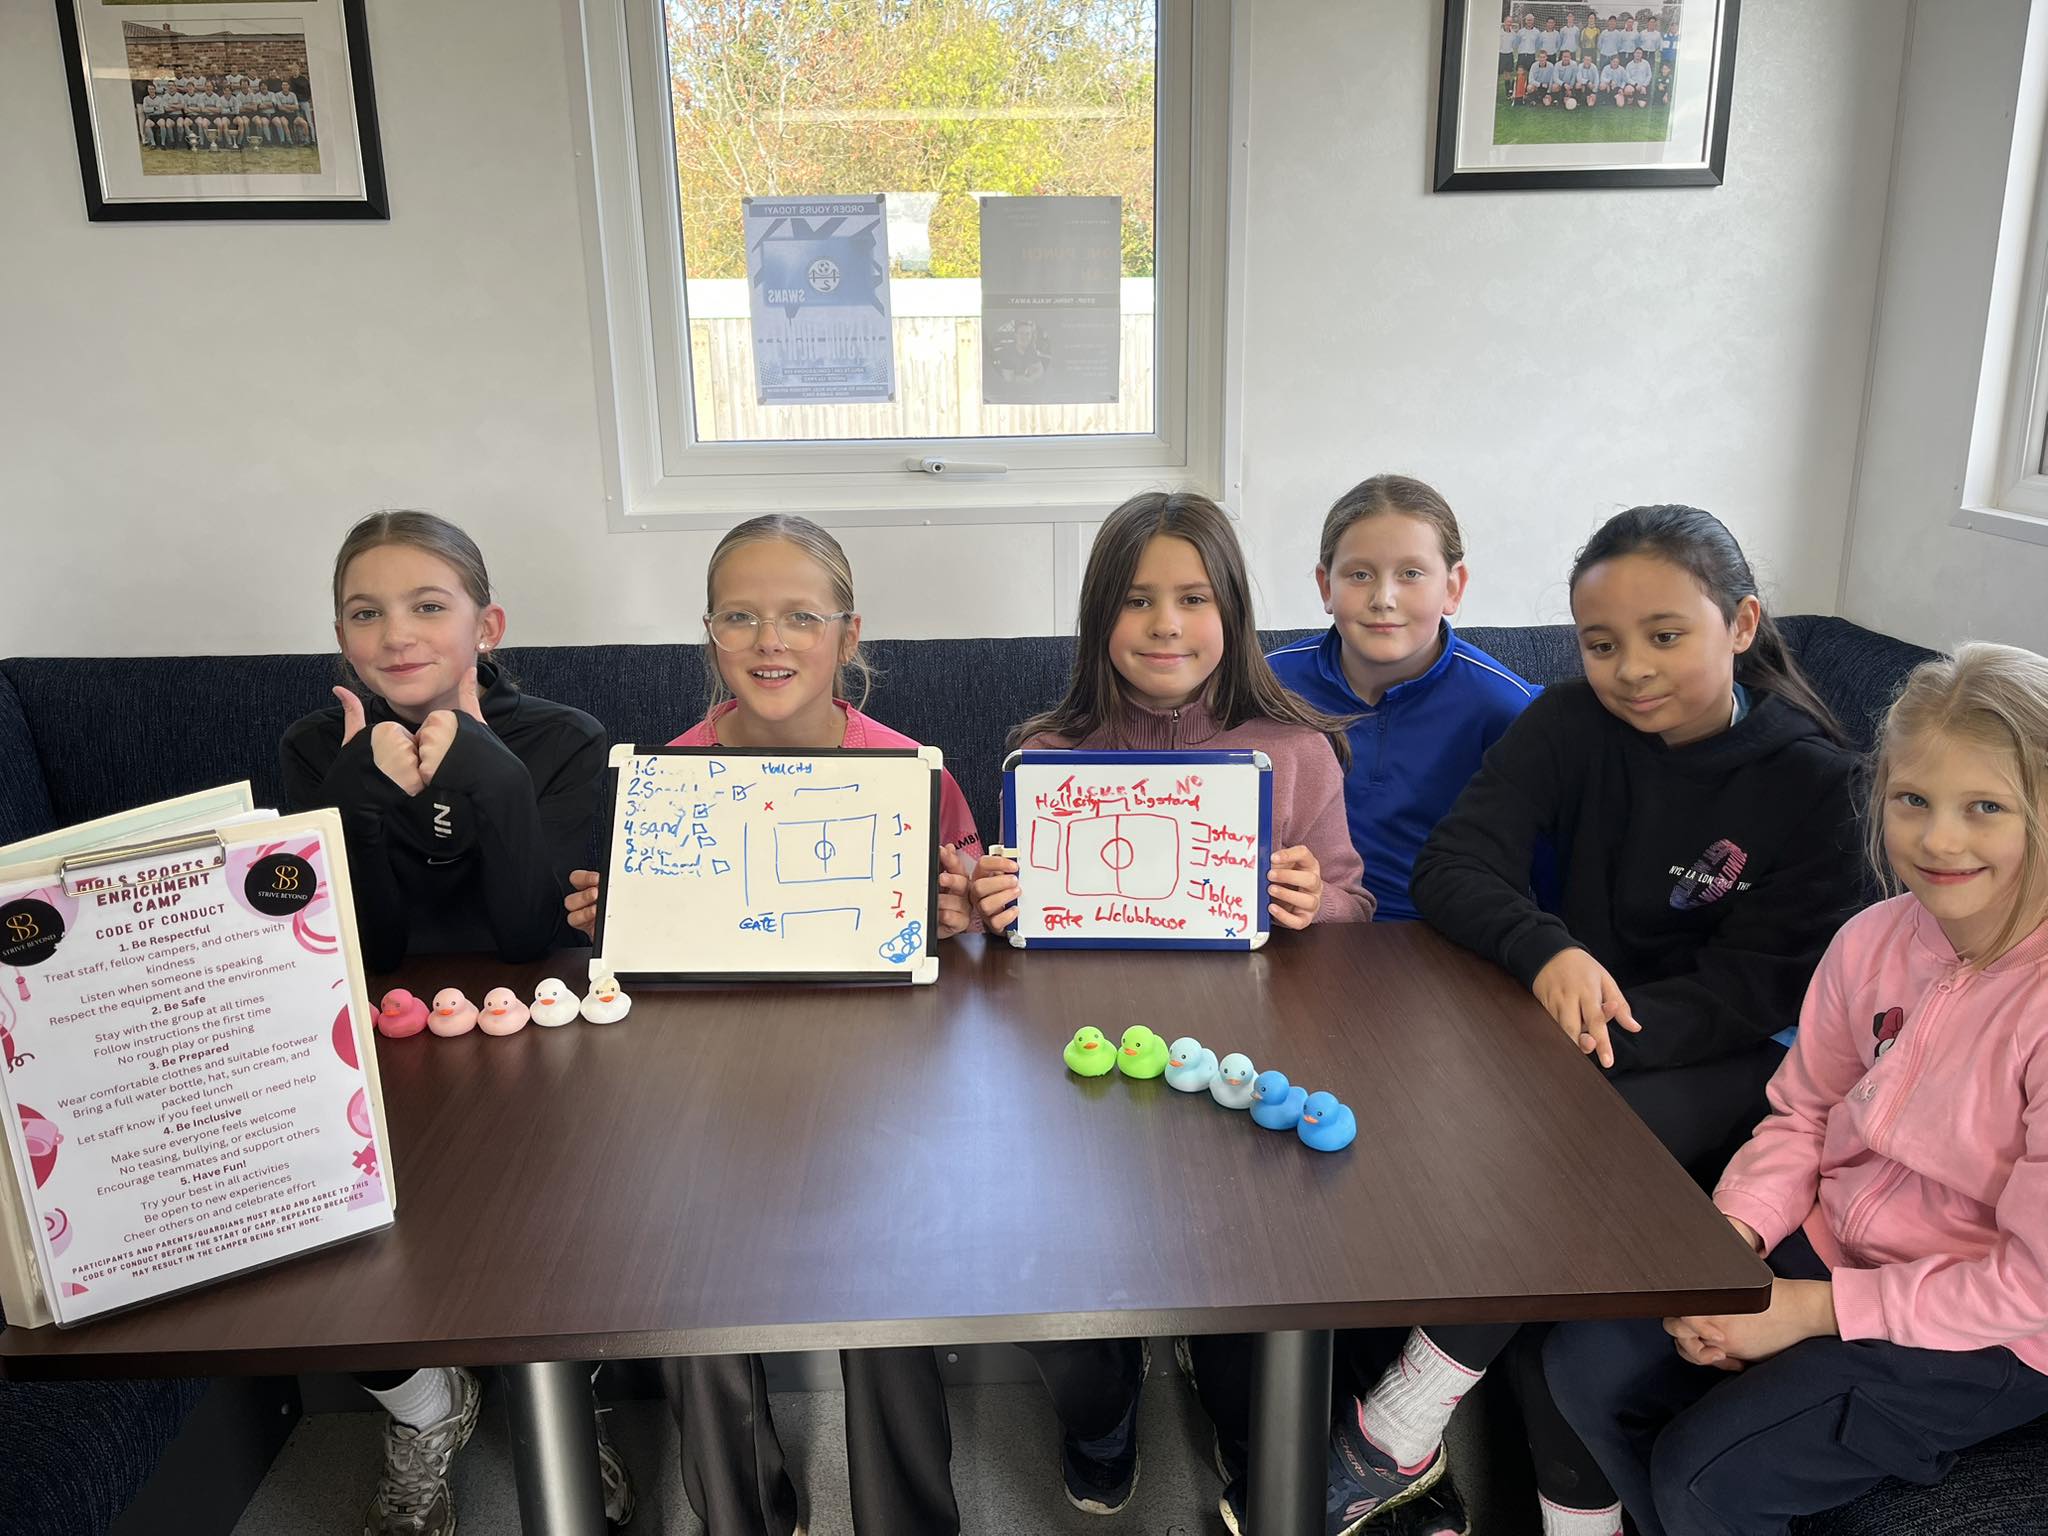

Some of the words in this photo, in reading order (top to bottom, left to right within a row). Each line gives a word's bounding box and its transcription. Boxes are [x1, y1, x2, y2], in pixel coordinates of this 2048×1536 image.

[96, 871, 211, 907] ENRICHMENT
[132, 892, 182, 914] CAMP
[281, 892, 308, 900] BEYOND
[26, 934, 56, 949] BEYOND
[95, 922, 134, 940] CODE
[138, 917, 156, 931] OF
[160, 903, 225, 926] CONDUCT
[118, 943, 130, 953] 1.
[131, 939, 148, 950] Be
[149, 923, 211, 946] Respectful
[42, 969, 76, 984] Treat
[77, 961, 108, 977] staff,
[109, 954, 145, 969] fellow
[147, 943, 200, 961] campers,
[201, 935, 223, 949] and
[224, 929, 260, 943] others
[261, 922, 285, 935] with
[145, 956, 196, 975] kindness
[49, 1008, 97, 1026] Respect
[97, 1003, 119, 1015] the
[120, 987, 182, 1009] equipment
[183, 980, 206, 994] and
[206, 977, 226, 989] the
[227, 960, 297, 983] environment
[79, 990, 116, 1005] Listen
[117, 981, 149, 996] when
[150, 969, 203, 988] someone
[203, 966, 214, 975] is
[215, 954, 264, 974] speaking
[94, 1030, 121, 1043] Stay
[122, 1023, 148, 1036] with
[149, 1018, 169, 1030] the
[171, 1009, 204, 1027] group
[206, 1006, 218, 1016] at
[219, 1001, 234, 1012] all
[234, 995, 265, 1009] times
[150, 1005, 162, 1016] 2.
[163, 1002, 180, 1013] Be
[180, 995, 207, 1008] Safe
[93, 1042, 131, 1058] Follow
[132, 1024, 201, 1048] instructions
[201, 1019, 221, 1031] the
[222, 1012, 246, 1025] first
[246, 1007, 272, 1019] time
[117, 1055, 134, 1065] No
[136, 1045, 170, 1061] rough
[171, 1039, 196, 1054] play
[197, 1035, 210, 1045] or
[211, 1024, 255, 1044] pushing
[148, 1061, 160, 1071] 3.
[160, 1058, 177, 1068] Be
[178, 1042, 230, 1064] Prepared
[57, 1095, 87, 1109] Wear
[89, 1075, 160, 1101] comfortable
[161, 1064, 203, 1081] clothes
[204, 1056, 226, 1070] and
[226, 1047, 270, 1064] suitable
[271, 1034, 319, 1052] footwear
[76, 1133, 97, 1146] Let
[97, 1124, 124, 1140] staff
[126, 1117, 156, 1132] know
[157, 1112, 166, 1124] if
[167, 1108, 190, 1124] you
[190, 1100, 213, 1115] feel
[213, 1090, 250, 1109] unwell
[251, 1088, 263, 1098] or
[265, 1079, 292, 1095] need
[293, 1074, 317, 1087] help
[163, 1126, 175, 1135] 4.
[175, 1121, 192, 1133] Be
[192, 1108, 242, 1128] Inclusive
[110, 1150, 141, 1165] Make
[142, 1142, 167, 1156] sure
[168, 1127, 221, 1148] everyone
[221, 1119, 248, 1133] feels
[249, 1106, 297, 1126] welcome
[119, 1165, 136, 1176] No
[137, 1152, 182, 1171] teasing,
[182, 1139, 229, 1158] bullying,
[230, 1134, 242, 1144] or
[244, 1120, 294, 1140] exclusion
[96, 1173, 156, 1196] Encourage
[157, 1155, 219, 1179] teammates
[220, 1146, 241, 1161] and
[241, 1135, 285, 1155] support
[286, 1126, 321, 1142] others
[179, 1176, 191, 1186] 5.
[192, 1168, 221, 1183] Have
[222, 1159, 247, 1174] Fun!
[140, 1199, 159, 1211] Try
[160, 1191, 187, 1208] your
[187, 1183, 214, 1198] best
[214, 1180, 226, 1190] in
[227, 1174, 241, 1186] all
[242, 1162, 290, 1182] activities
[143, 1213, 160, 1224] Be
[160, 1202, 190, 1219] open
[190, 1200, 203, 1211] to
[204, 1193, 227, 1206] new
[229, 1174, 293, 1199] experiences
[71, 1250, 134, 1275] PARTICIPANTS
[136, 1245, 154, 1256] AND
[155, 1217, 245, 1250] PARENTS/GUARDIANS
[246, 1210, 268, 1223] MUST
[269, 1203, 292, 1216] READ
[293, 1198, 310, 1209] AND
[311, 1189, 338, 1203] AGREE
[338, 1185, 350, 1195] TO
[351, 1180, 369, 1191] THIS
[123, 1227, 156, 1244] Cheer
[158, 1216, 195, 1233] others
[195, 1211, 211, 1222] on
[212, 1203, 233, 1218] and
[234, 1189, 285, 1211] celebrate
[286, 1180, 317, 1195] effort
